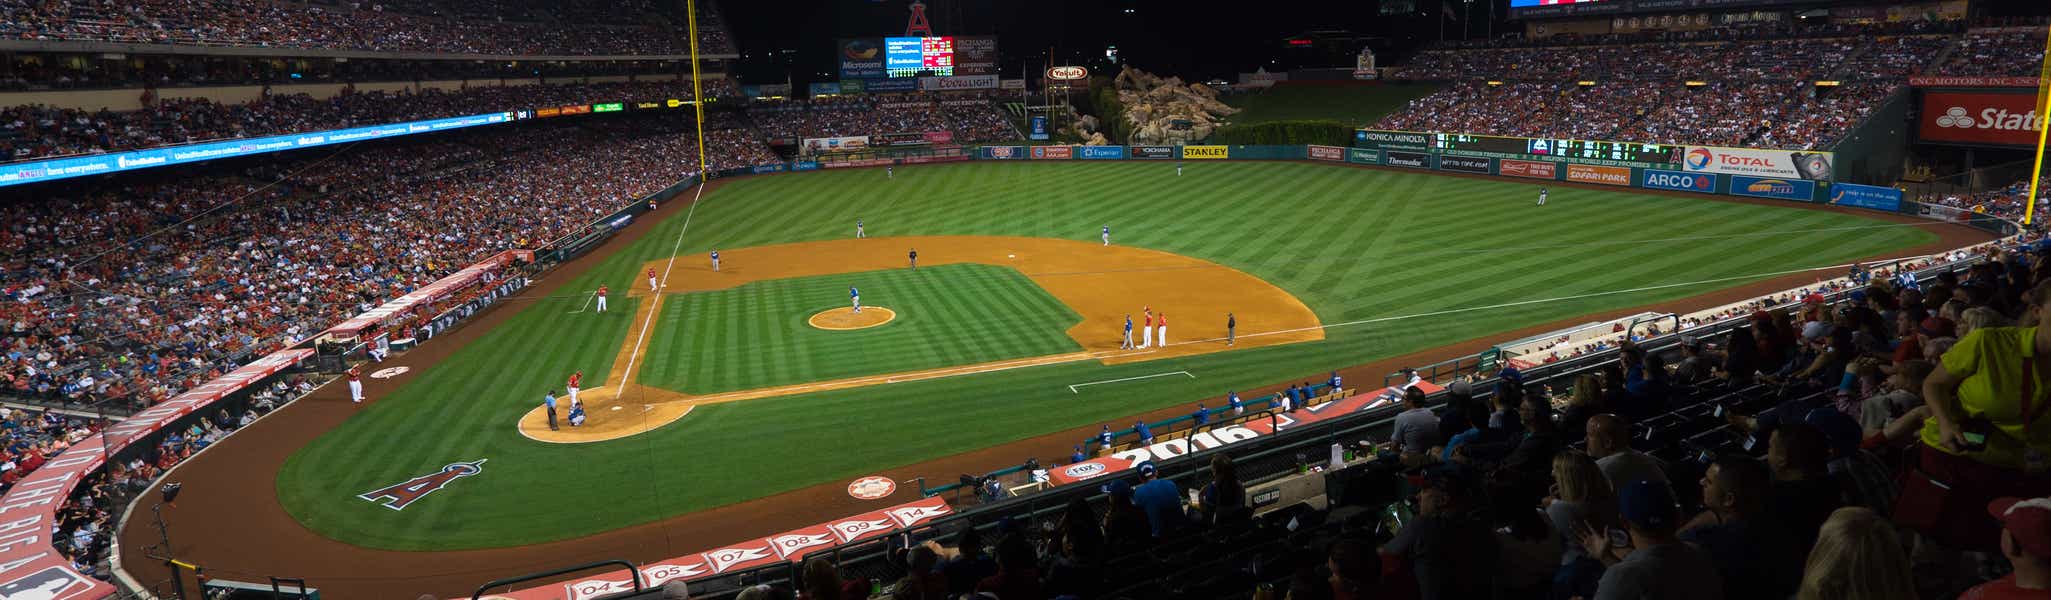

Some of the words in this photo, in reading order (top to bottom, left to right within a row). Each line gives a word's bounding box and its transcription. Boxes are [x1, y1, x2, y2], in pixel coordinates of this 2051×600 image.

[905, 3, 932, 37] A
[1054, 69, 1083, 77] Yakult
[968, 78, 993, 88] LIGHT
[1367, 132, 1393, 141] KONICA
[1394, 134, 1426, 143] MINOLTA
[1093, 150, 1119, 158] Experian
[1184, 148, 1227, 156] STANLEY
[1718, 153, 1776, 167] TOTAL
[1570, 170, 1601, 180] SAFARI
[1602, 173, 1627, 182] PARK
[1647, 173, 1694, 188] ARCO
[1111, 424, 1258, 468] 2016
[357, 458, 488, 512] A
